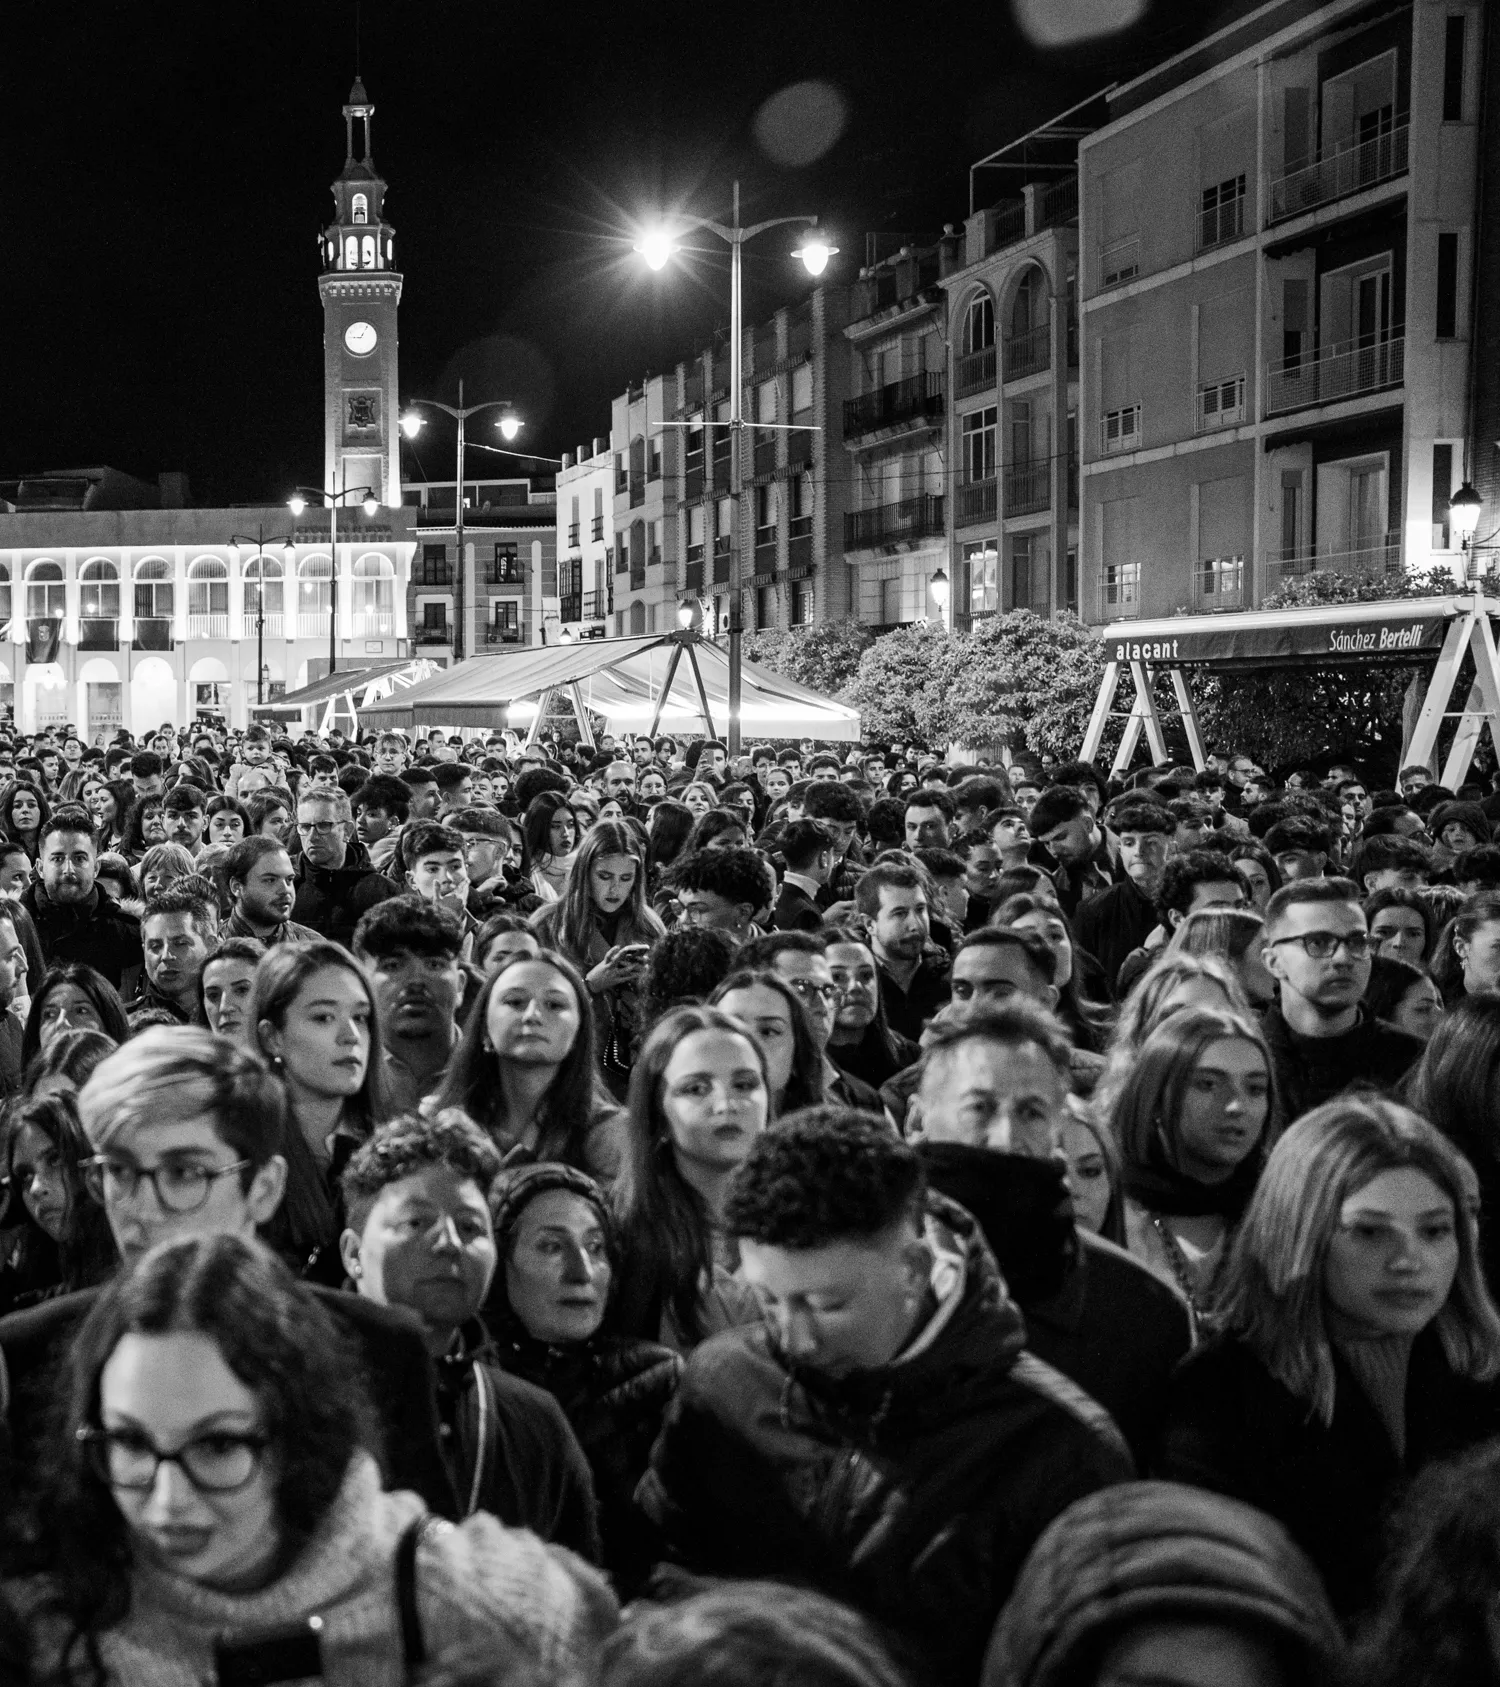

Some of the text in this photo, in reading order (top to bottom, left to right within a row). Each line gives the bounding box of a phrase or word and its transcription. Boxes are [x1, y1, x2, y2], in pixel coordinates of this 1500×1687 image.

[1116, 639, 1179, 660] alacant
[1329, 624, 1424, 651] Sánchez Bertelli
